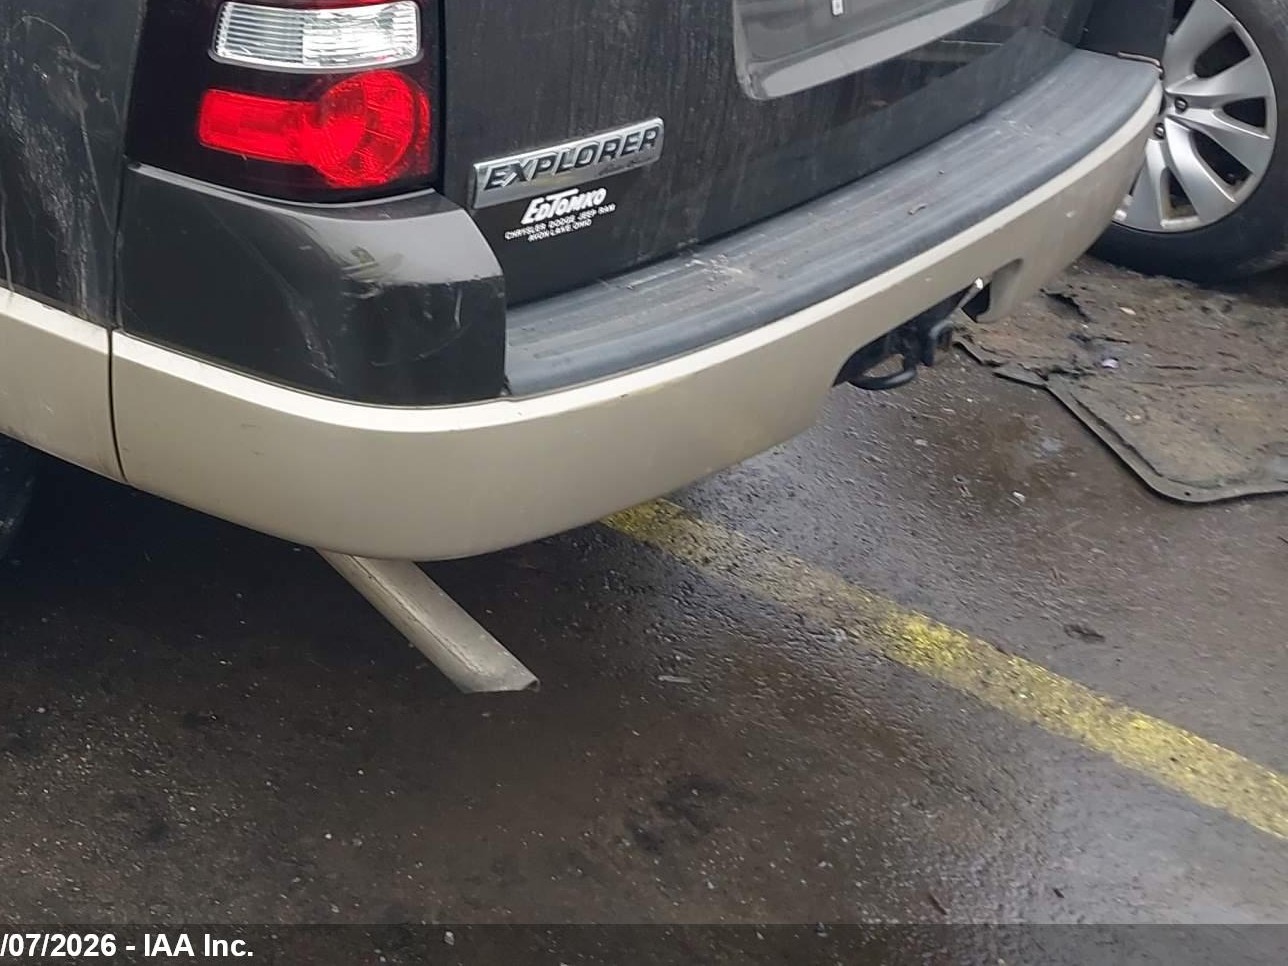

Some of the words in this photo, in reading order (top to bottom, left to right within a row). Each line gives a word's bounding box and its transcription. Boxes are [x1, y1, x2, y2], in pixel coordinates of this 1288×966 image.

[483, 126, 660, 191] EXPLORER
[528, 230, 550, 241] AVON
[573, 218, 592, 230] OHIO
[548, 214, 576, 229] DODGE
[577, 209, 597, 220] JEEP
